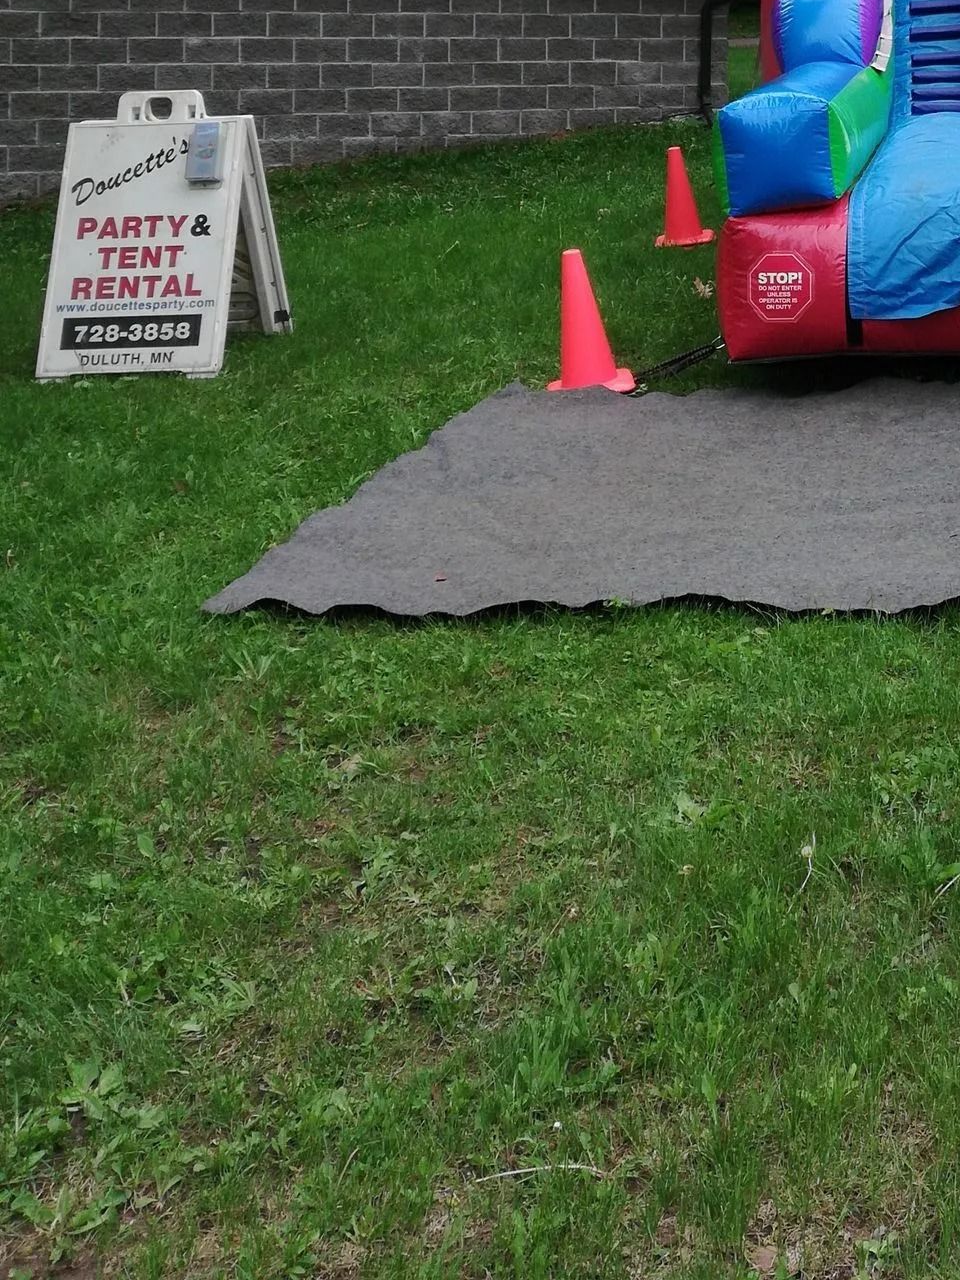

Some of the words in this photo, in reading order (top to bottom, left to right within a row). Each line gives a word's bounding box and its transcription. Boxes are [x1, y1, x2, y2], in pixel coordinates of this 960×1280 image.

[71, 136, 189, 206] Doucette's
[76, 215, 189, 239] PARTY
[190, 214, 211, 237] &
[97, 245, 184, 270] TENT
[70, 273, 202, 300] RENTAL
[758, 272, 803, 284] STOP!
[56, 298, 215, 314] www.doucettesparty.com
[74, 322, 191, 343] 728-3858
[80, 353, 145, 366] DULUTH,
[150, 351, 173, 363] MN
